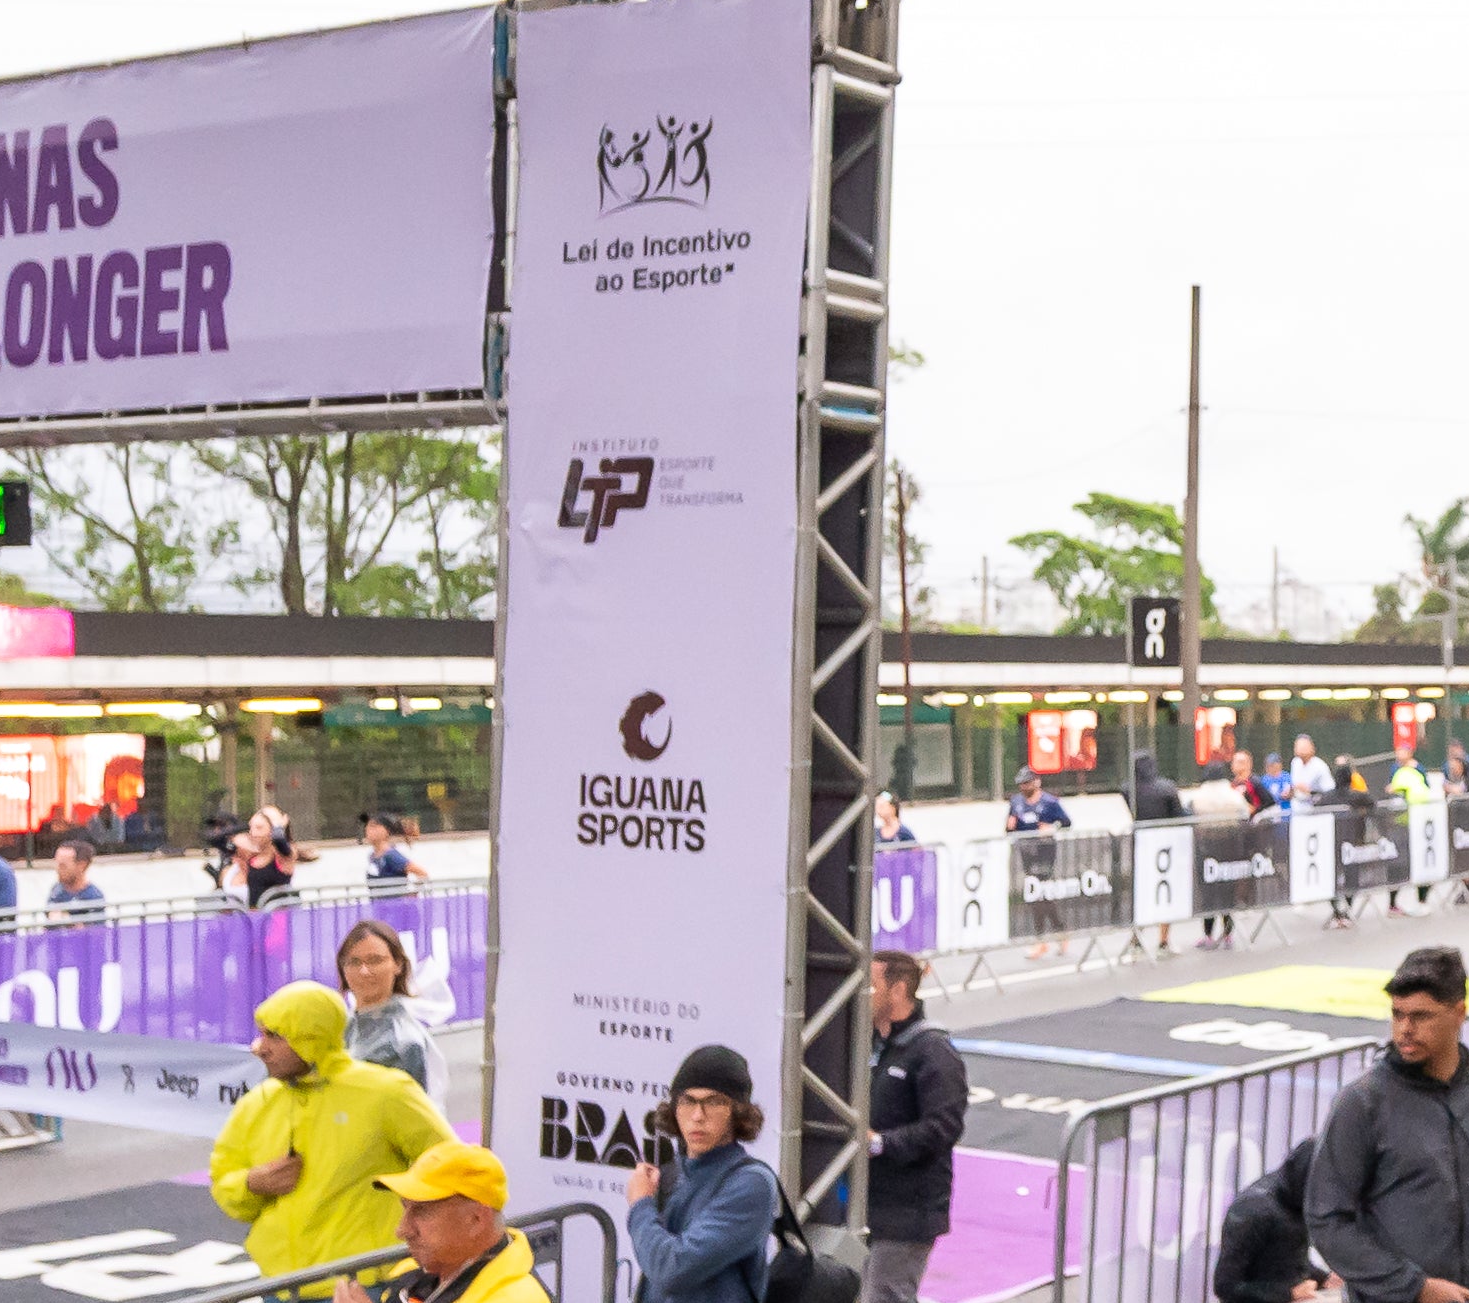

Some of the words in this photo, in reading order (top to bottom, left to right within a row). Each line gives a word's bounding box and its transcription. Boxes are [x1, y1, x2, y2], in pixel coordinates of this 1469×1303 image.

[563, 238, 597, 263] Lei
[606, 237, 634, 259] de
[643, 227, 751, 256] Incentivo
[596, 274, 624, 292] ao
[572, 437, 659, 452] INSTITUTO
[580, 774, 707, 814] IGUANA
[577, 812, 706, 852] SPORTS
[599, 1020, 674, 1043] ESPORTE
[557, 1070, 635, 1094] GOVERNO
[540, 1095, 676, 1170] BRAS
